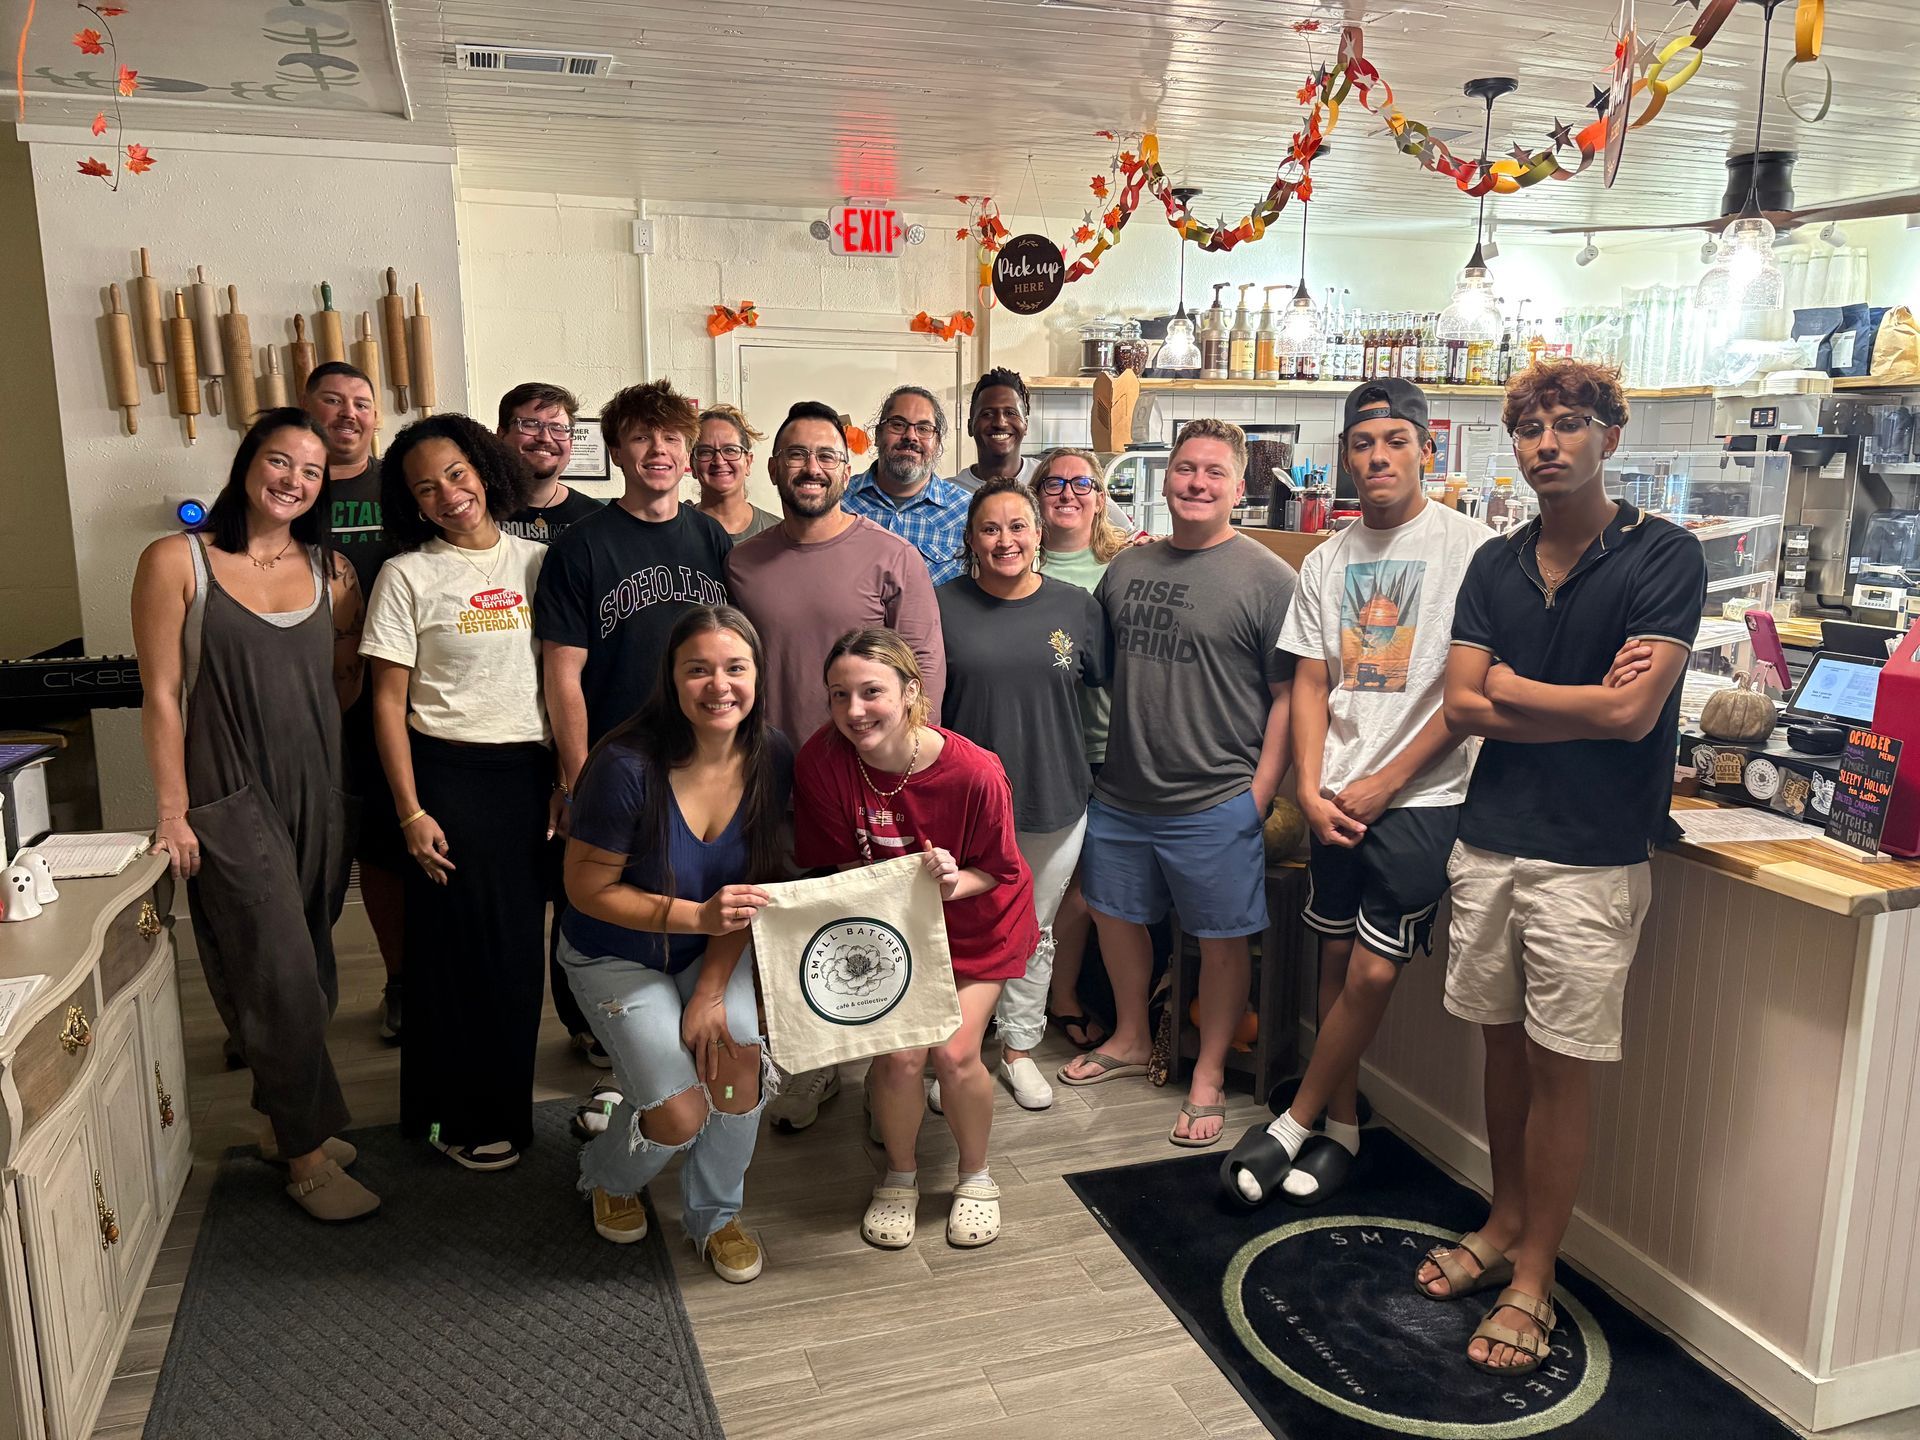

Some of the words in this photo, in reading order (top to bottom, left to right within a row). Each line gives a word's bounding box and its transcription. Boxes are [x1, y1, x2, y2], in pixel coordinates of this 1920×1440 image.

[844, 208, 896, 253] EXIT
[998, 255, 1034, 283] Pick
[1036, 261, 1062, 283] up
[1014, 281, 1045, 294] HERE
[474, 590, 517, 602] ELEVATION
[481, 599, 516, 609] RHYTHM
[1123, 579, 1190, 608] RISE
[456, 618, 520, 635] YESTERDAY
[459, 609, 514, 622] GOODBYE
[1117, 602, 1174, 631] AND
[1117, 627, 1198, 664] GRIND
[1849, 730, 1891, 753] OCTOBER
[1715, 764, 1739, 773] COFFEE
[1878, 752, 1896, 763] MENU
[1839, 769, 1862, 788] SLEEPY
[1863, 778, 1892, 797] HOLLOW
[1831, 807, 1874, 835] WITCHES
[1846, 828, 1878, 851] POTION
[811, 933, 838, 980] SMALL
[846, 927, 903, 963] BATCHES
[857, 997, 888, 1006] collective
